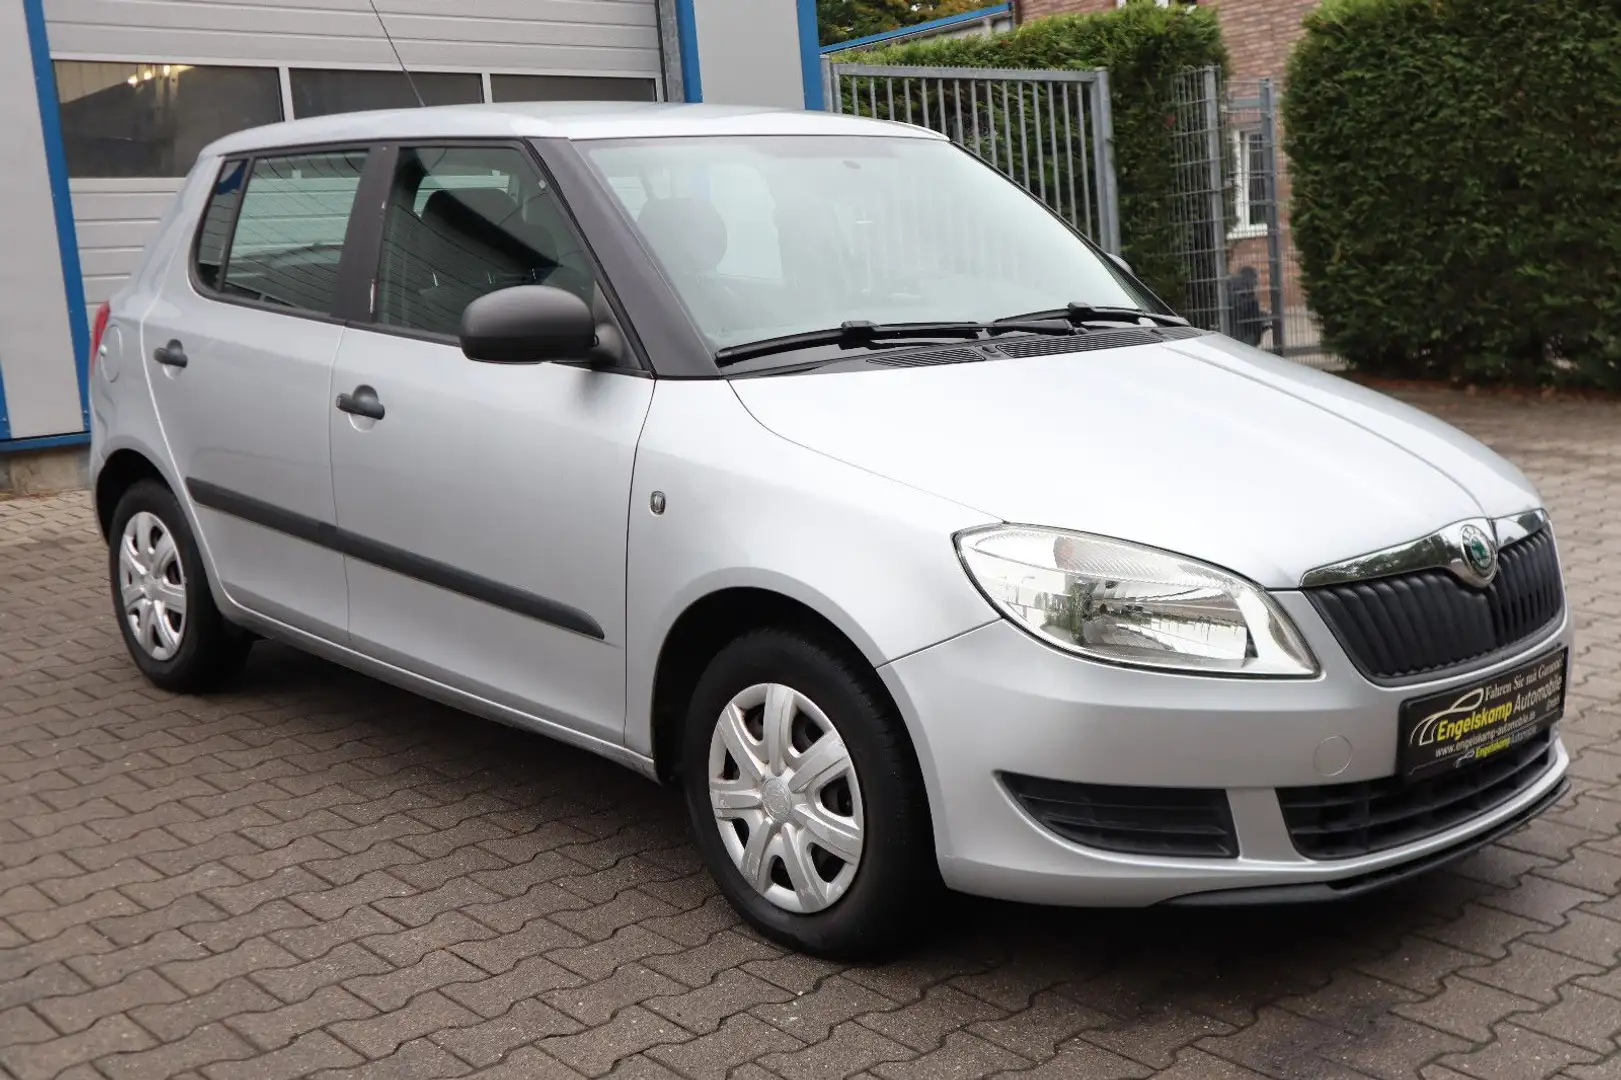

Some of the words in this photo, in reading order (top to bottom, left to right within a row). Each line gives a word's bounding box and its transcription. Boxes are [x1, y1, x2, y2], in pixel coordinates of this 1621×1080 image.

[1437, 701, 1513, 741] Engelskamp
[1513, 674, 1563, 713] Automobile
[1485, 682, 1512, 701] Fahren
[1513, 673, 1525, 690] Sie
